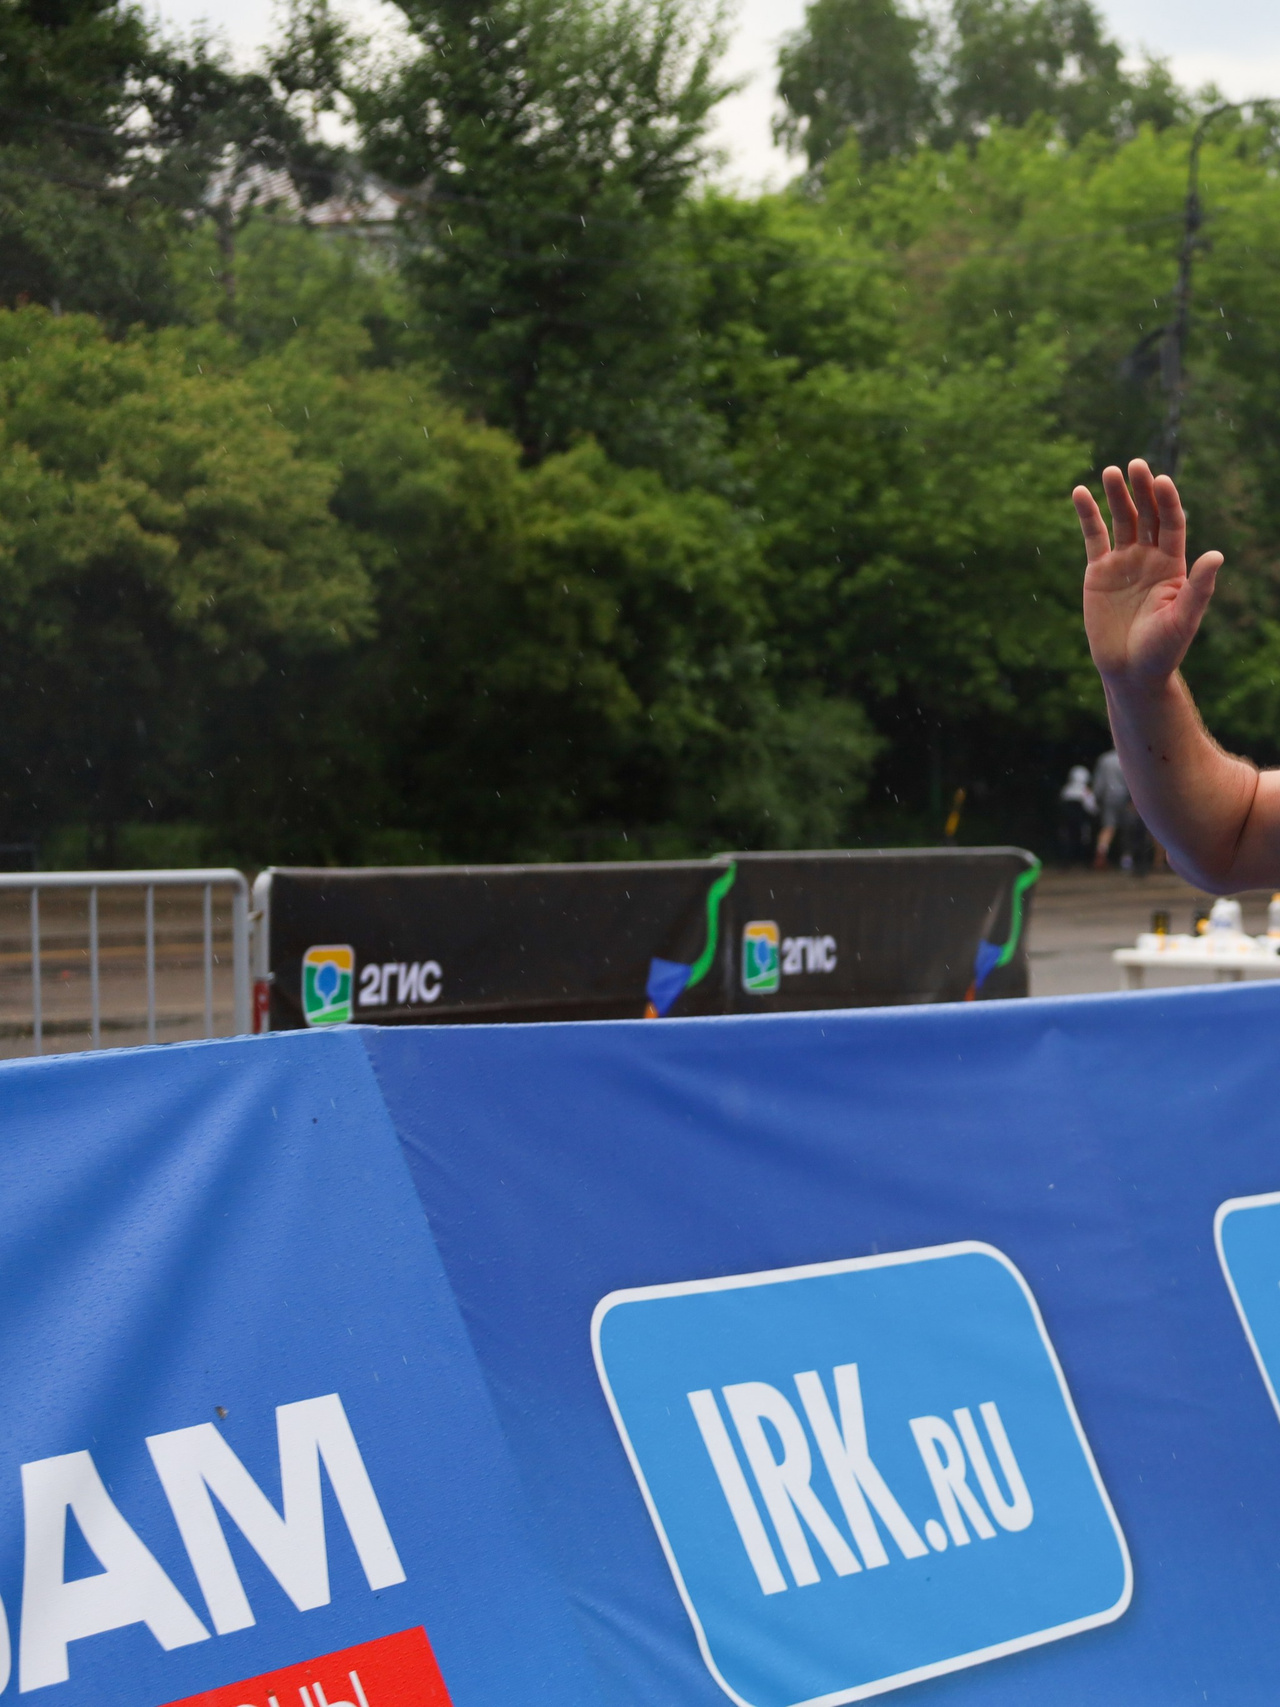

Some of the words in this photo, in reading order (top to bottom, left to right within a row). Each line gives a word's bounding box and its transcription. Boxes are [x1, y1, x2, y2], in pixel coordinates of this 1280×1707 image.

[359, 960, 443, 1006] 2ГИС
[782, 934, 837, 975] 2ГИС
[0, 1393, 407, 1694] АМ
[687, 1362, 1035, 1596] IRK.RU
